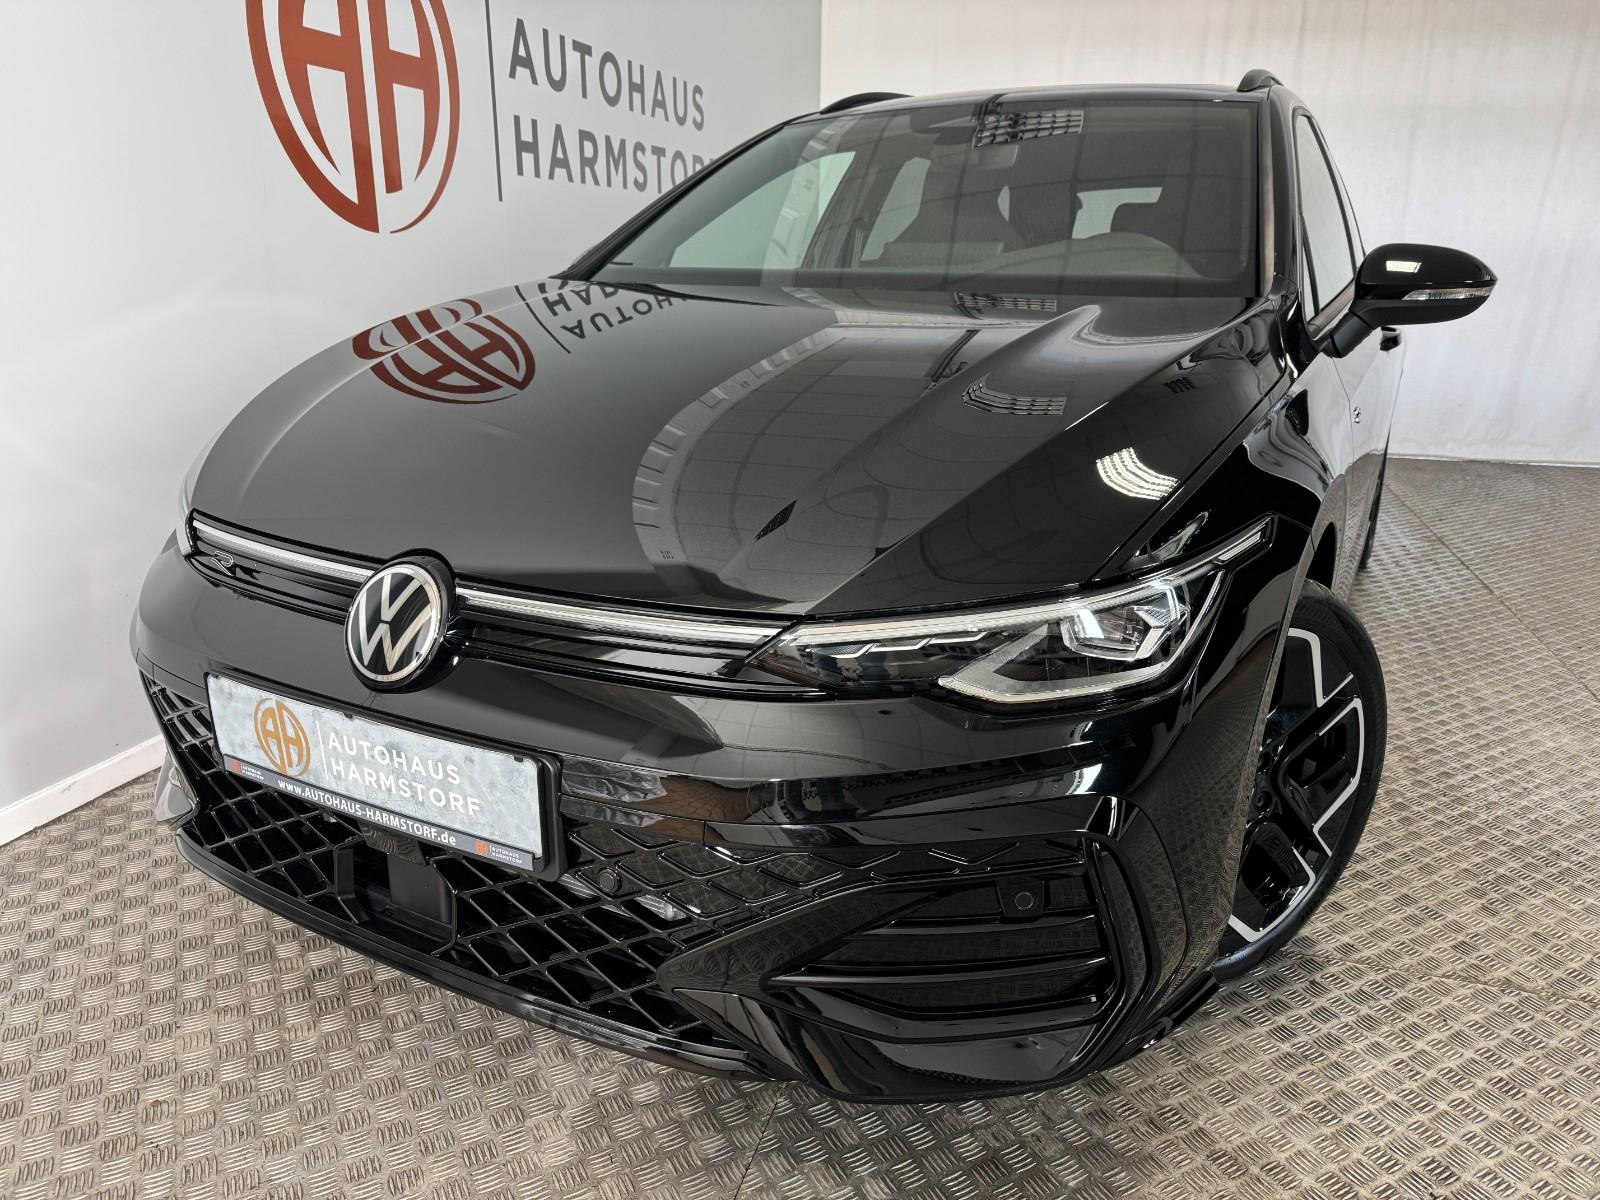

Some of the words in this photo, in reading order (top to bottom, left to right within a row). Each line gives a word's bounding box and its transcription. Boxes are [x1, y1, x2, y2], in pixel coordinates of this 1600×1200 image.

[508, 17, 704, 131] AUTOHAUS
[513, 114, 717, 194] HARMSTO
[328, 732, 461, 785] AUTOHAUS
[330, 758, 481, 816] HARMSTORF
[277, 779, 457, 845] www.AUTOHAUS-HARMSTORF.de
